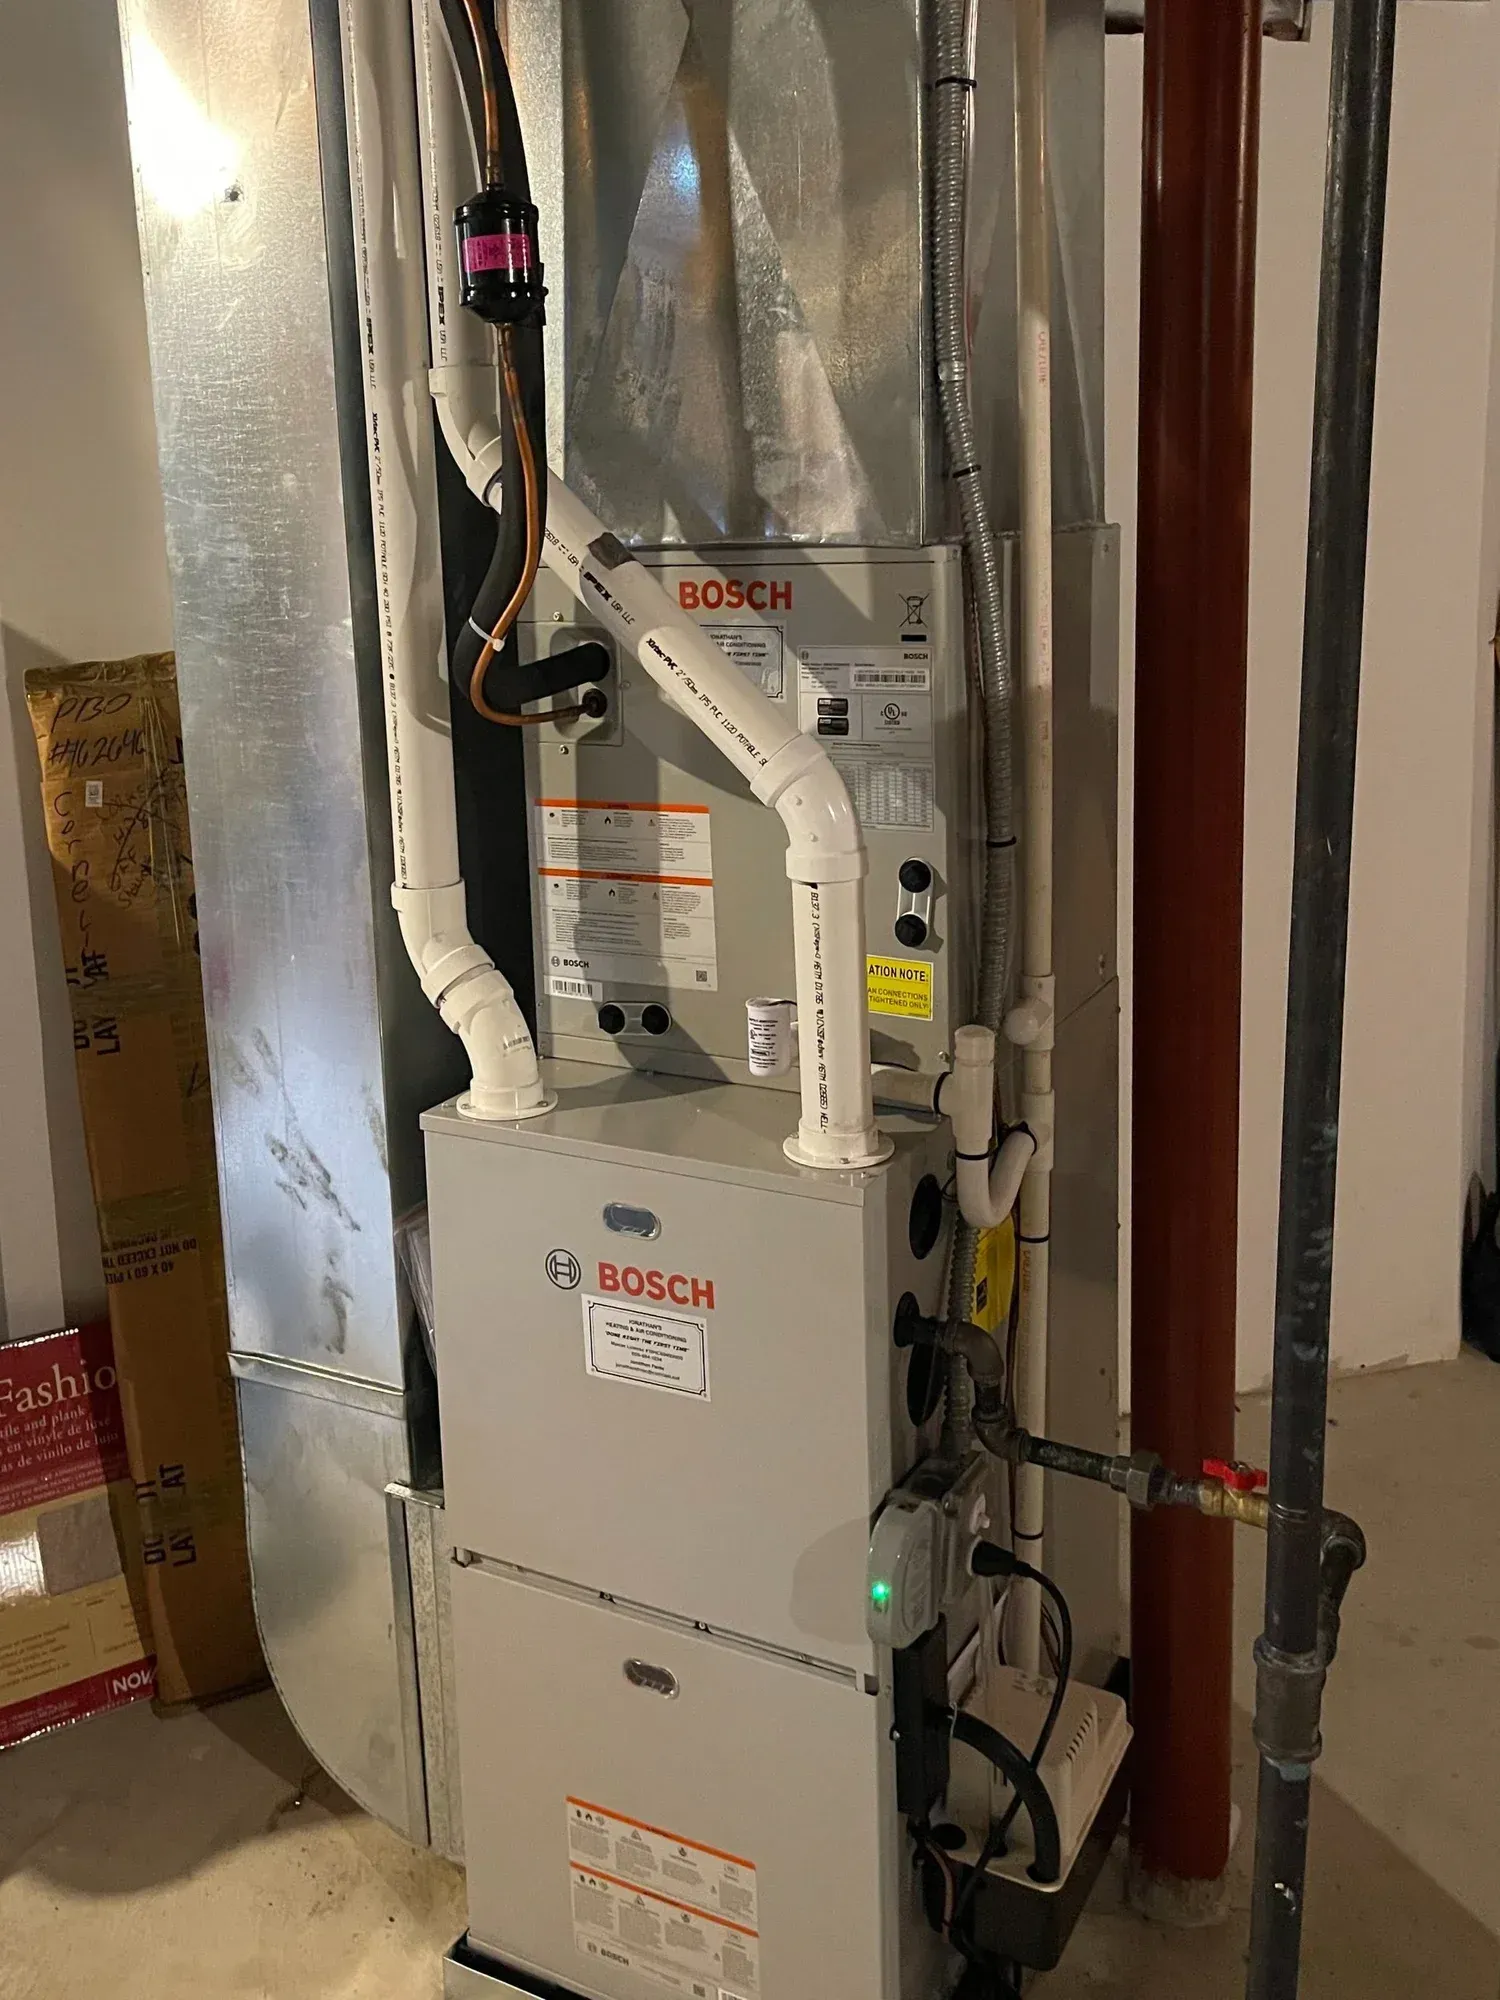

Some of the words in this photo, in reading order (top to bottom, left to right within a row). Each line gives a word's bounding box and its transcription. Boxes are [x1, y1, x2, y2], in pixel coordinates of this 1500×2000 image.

[583, 571, 612, 601] IPEX
[621, 612, 635, 624] LLC
[679, 580, 792, 610] BOSCH
[698, 694, 711, 706] IPS
[709, 705, 722, 718] PVC
[721, 719, 737, 734] 1120
[736, 733, 760, 758] POTABLE
[810, 892, 819, 919] B137.3
[563, 958, 590, 969] BOSCH
[814, 961, 822, 979] ASTM
[814, 981, 823, 1004] D1785
[869, 995, 908, 1008] TIGHTENED
[878, 988, 928, 1001] CONNECTIONS
[818, 1062, 826, 1081] ASTM
[117, 1247, 157, 1267] EXCEED
[160, 1242, 181, 1257] NOT
[598, 1261, 715, 1310] BOSCH
[645, 1329, 687, 1343] CONDITIONING
[0, 1359, 116, 1418] Fashio
[23, 1415, 47, 1432] and
[51, 1405, 85, 1428] plank
[26, 1427, 63, 1448] vinyle
[67, 1423, 82, 1437] de
[18, 1454, 33, 1468] de
[36, 1443, 72, 1462] vinilo
[76, 1437, 91, 1451] de
[601, 1948, 630, 1966] BOSCH
